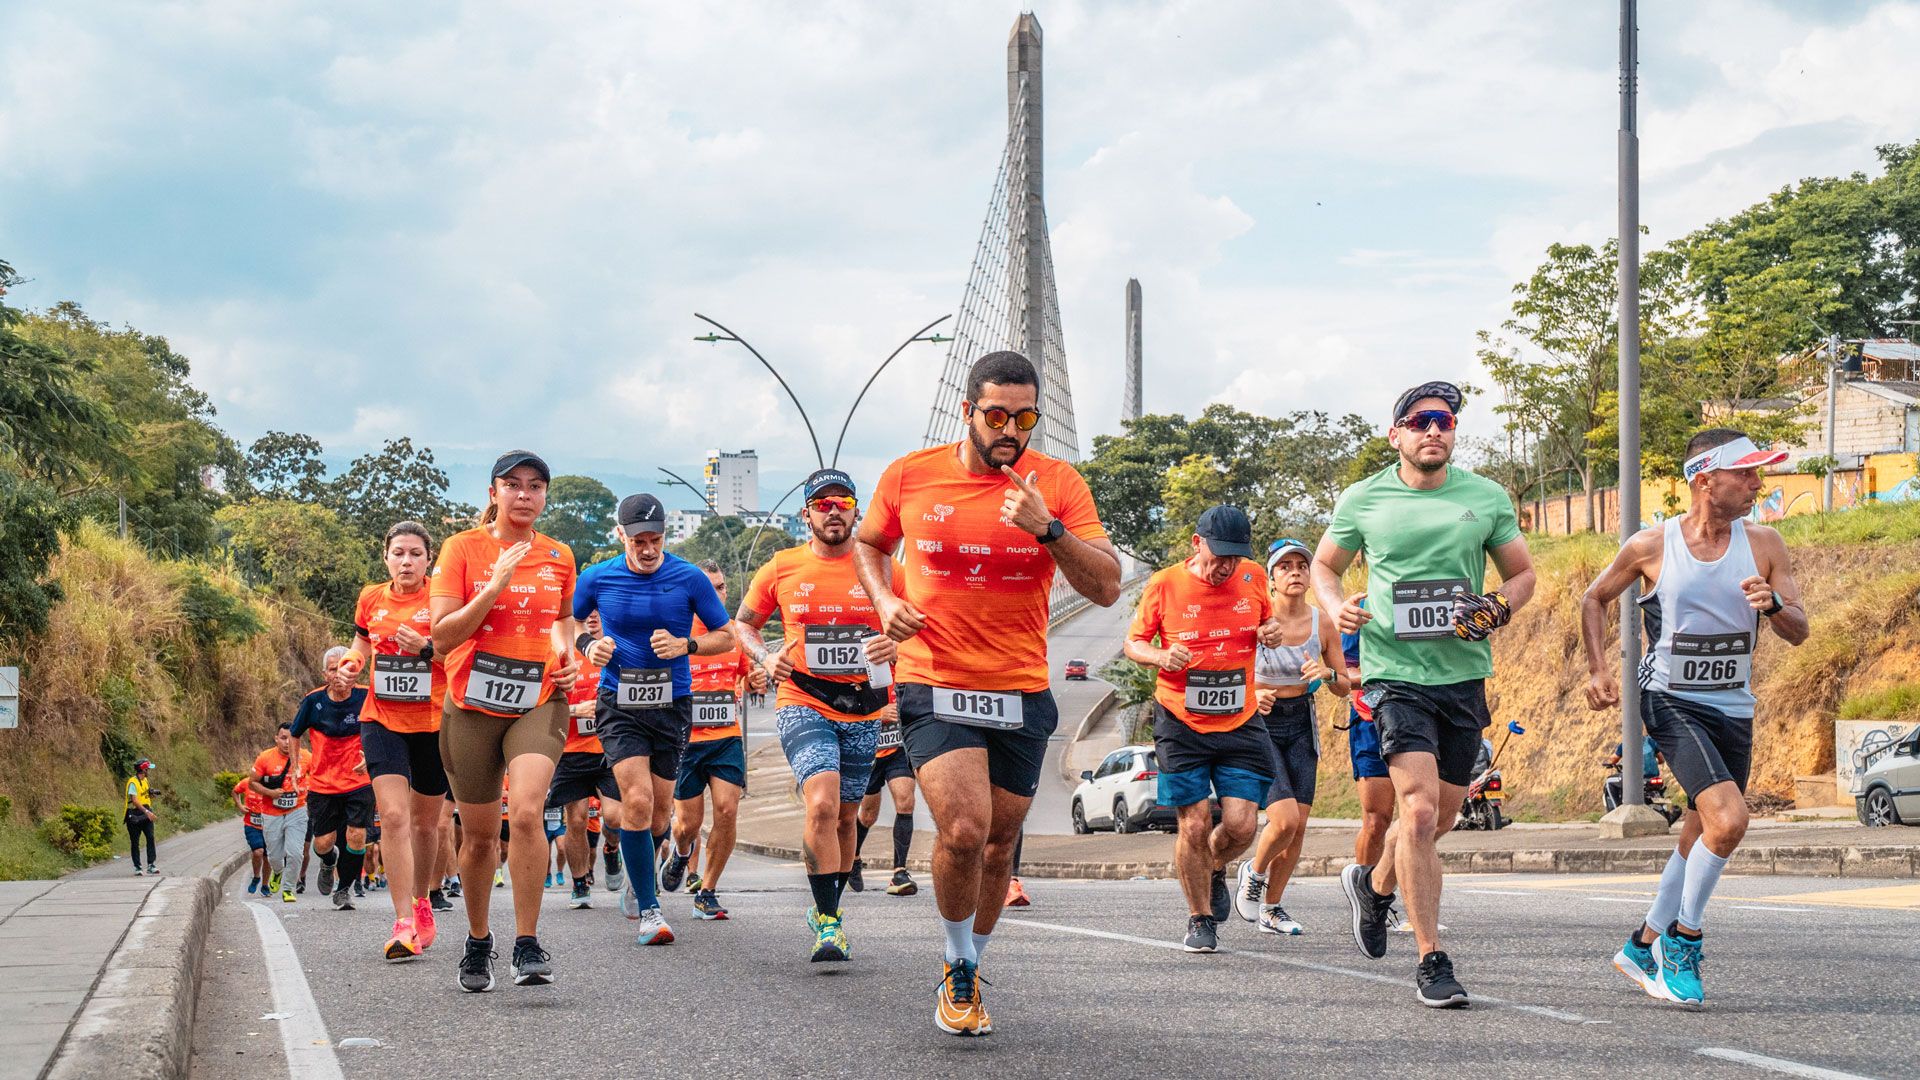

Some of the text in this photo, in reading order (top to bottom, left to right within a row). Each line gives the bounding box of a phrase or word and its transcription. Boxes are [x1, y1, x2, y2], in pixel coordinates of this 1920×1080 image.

[812, 474, 847, 486] GARMIN
[1408, 605, 1454, 628] 003
[817, 647, 859, 665] 0152
[1683, 659, 1737, 681] 0266
[384, 675, 419, 693] 1152
[485, 680, 526, 704] 1127
[628, 686, 663, 702] 0237
[1197, 689, 1237, 706] 0261
[699, 706, 728, 720] 0018
[952, 692, 1004, 717] 0131
